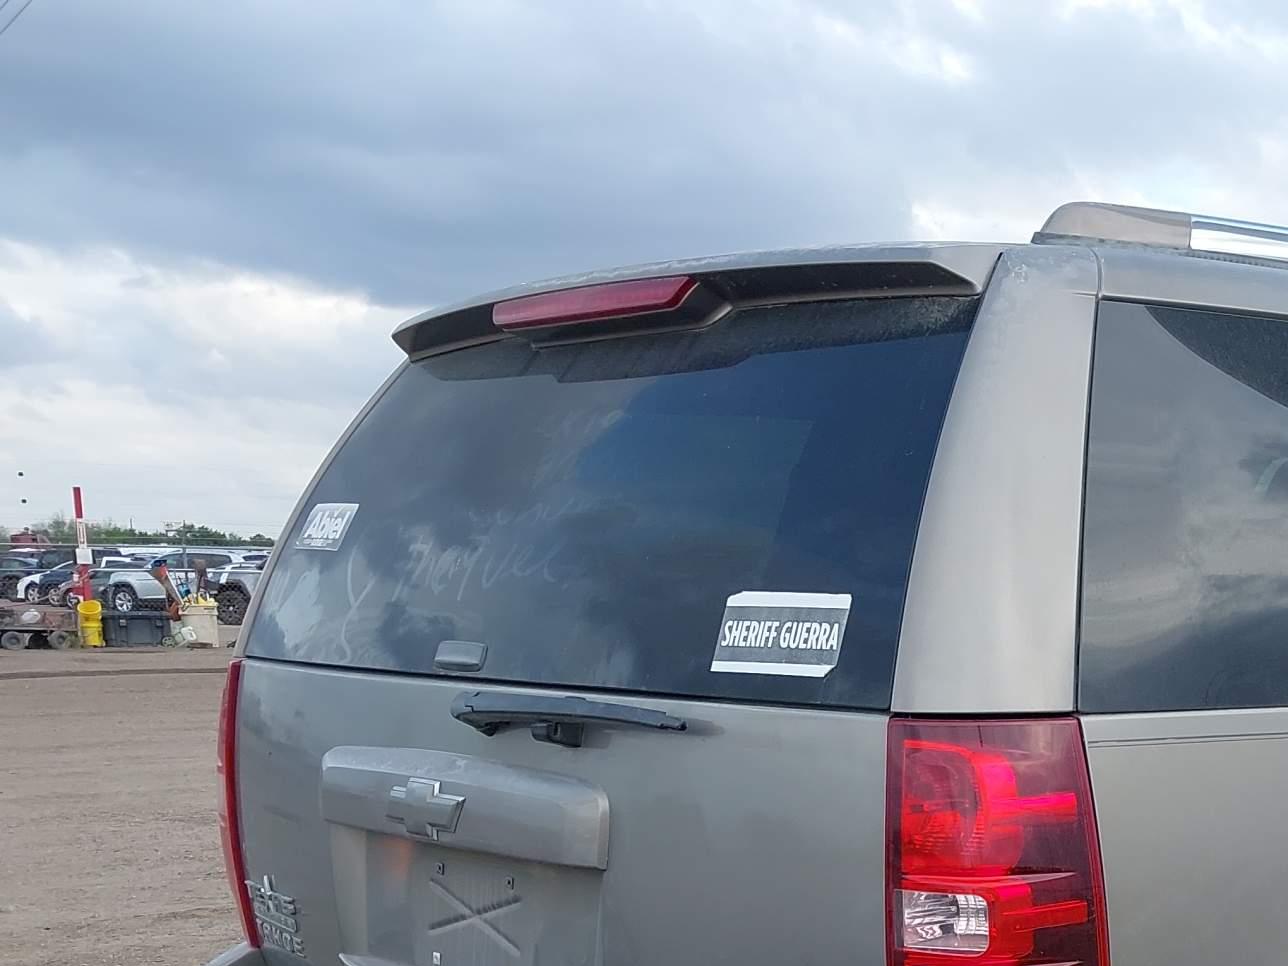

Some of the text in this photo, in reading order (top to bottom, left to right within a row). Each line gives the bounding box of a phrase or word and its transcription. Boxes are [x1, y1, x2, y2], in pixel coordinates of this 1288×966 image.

[303, 510, 351, 539] Abiel
[720, 620, 839, 650] SHERIFF GUERRA
